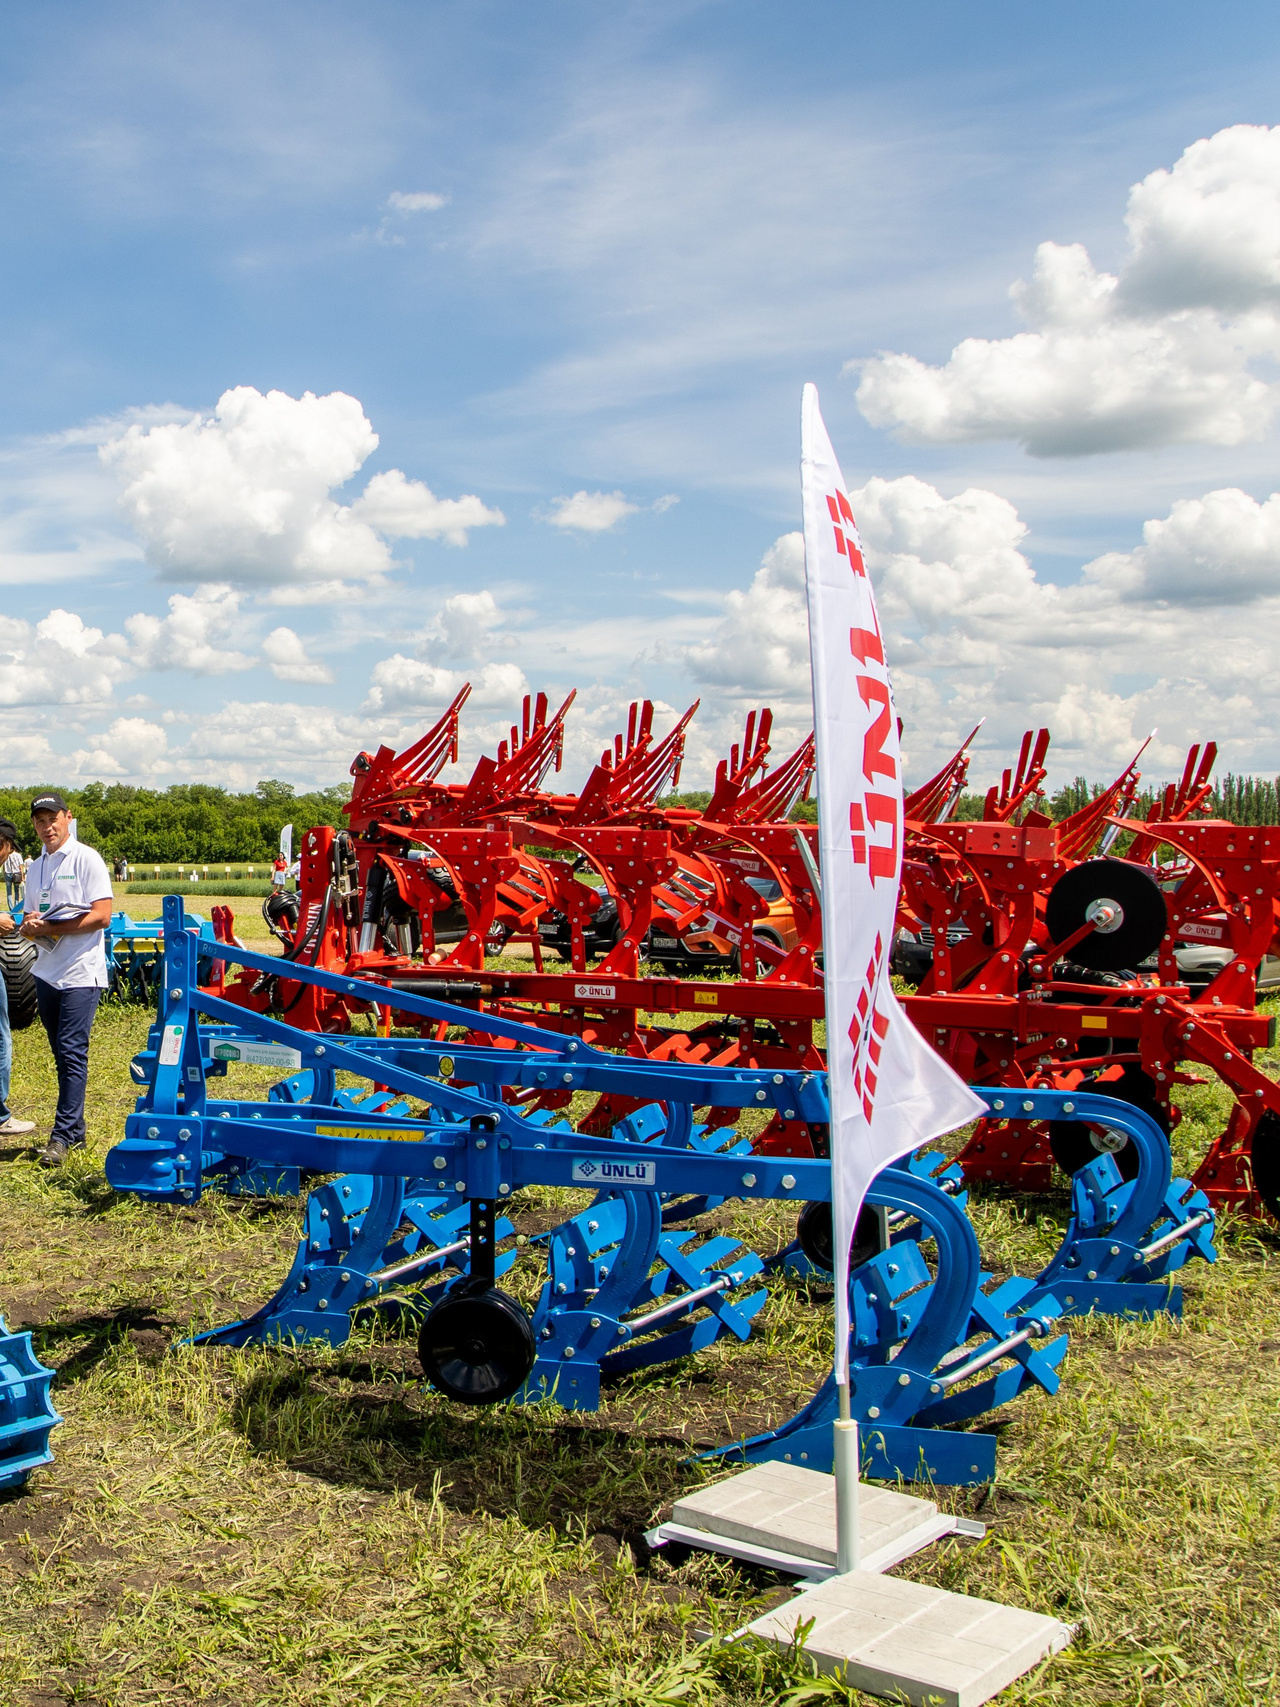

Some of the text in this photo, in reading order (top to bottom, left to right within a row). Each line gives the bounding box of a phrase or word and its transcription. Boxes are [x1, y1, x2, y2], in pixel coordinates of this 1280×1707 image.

[826, 488, 898, 890] ÜNLÜ
[1195, 926, 1216, 936] ÜNLÜ
[589, 986, 611, 996] ÜNLÜ
[601, 1161, 647, 1179] ÜNLÜ
